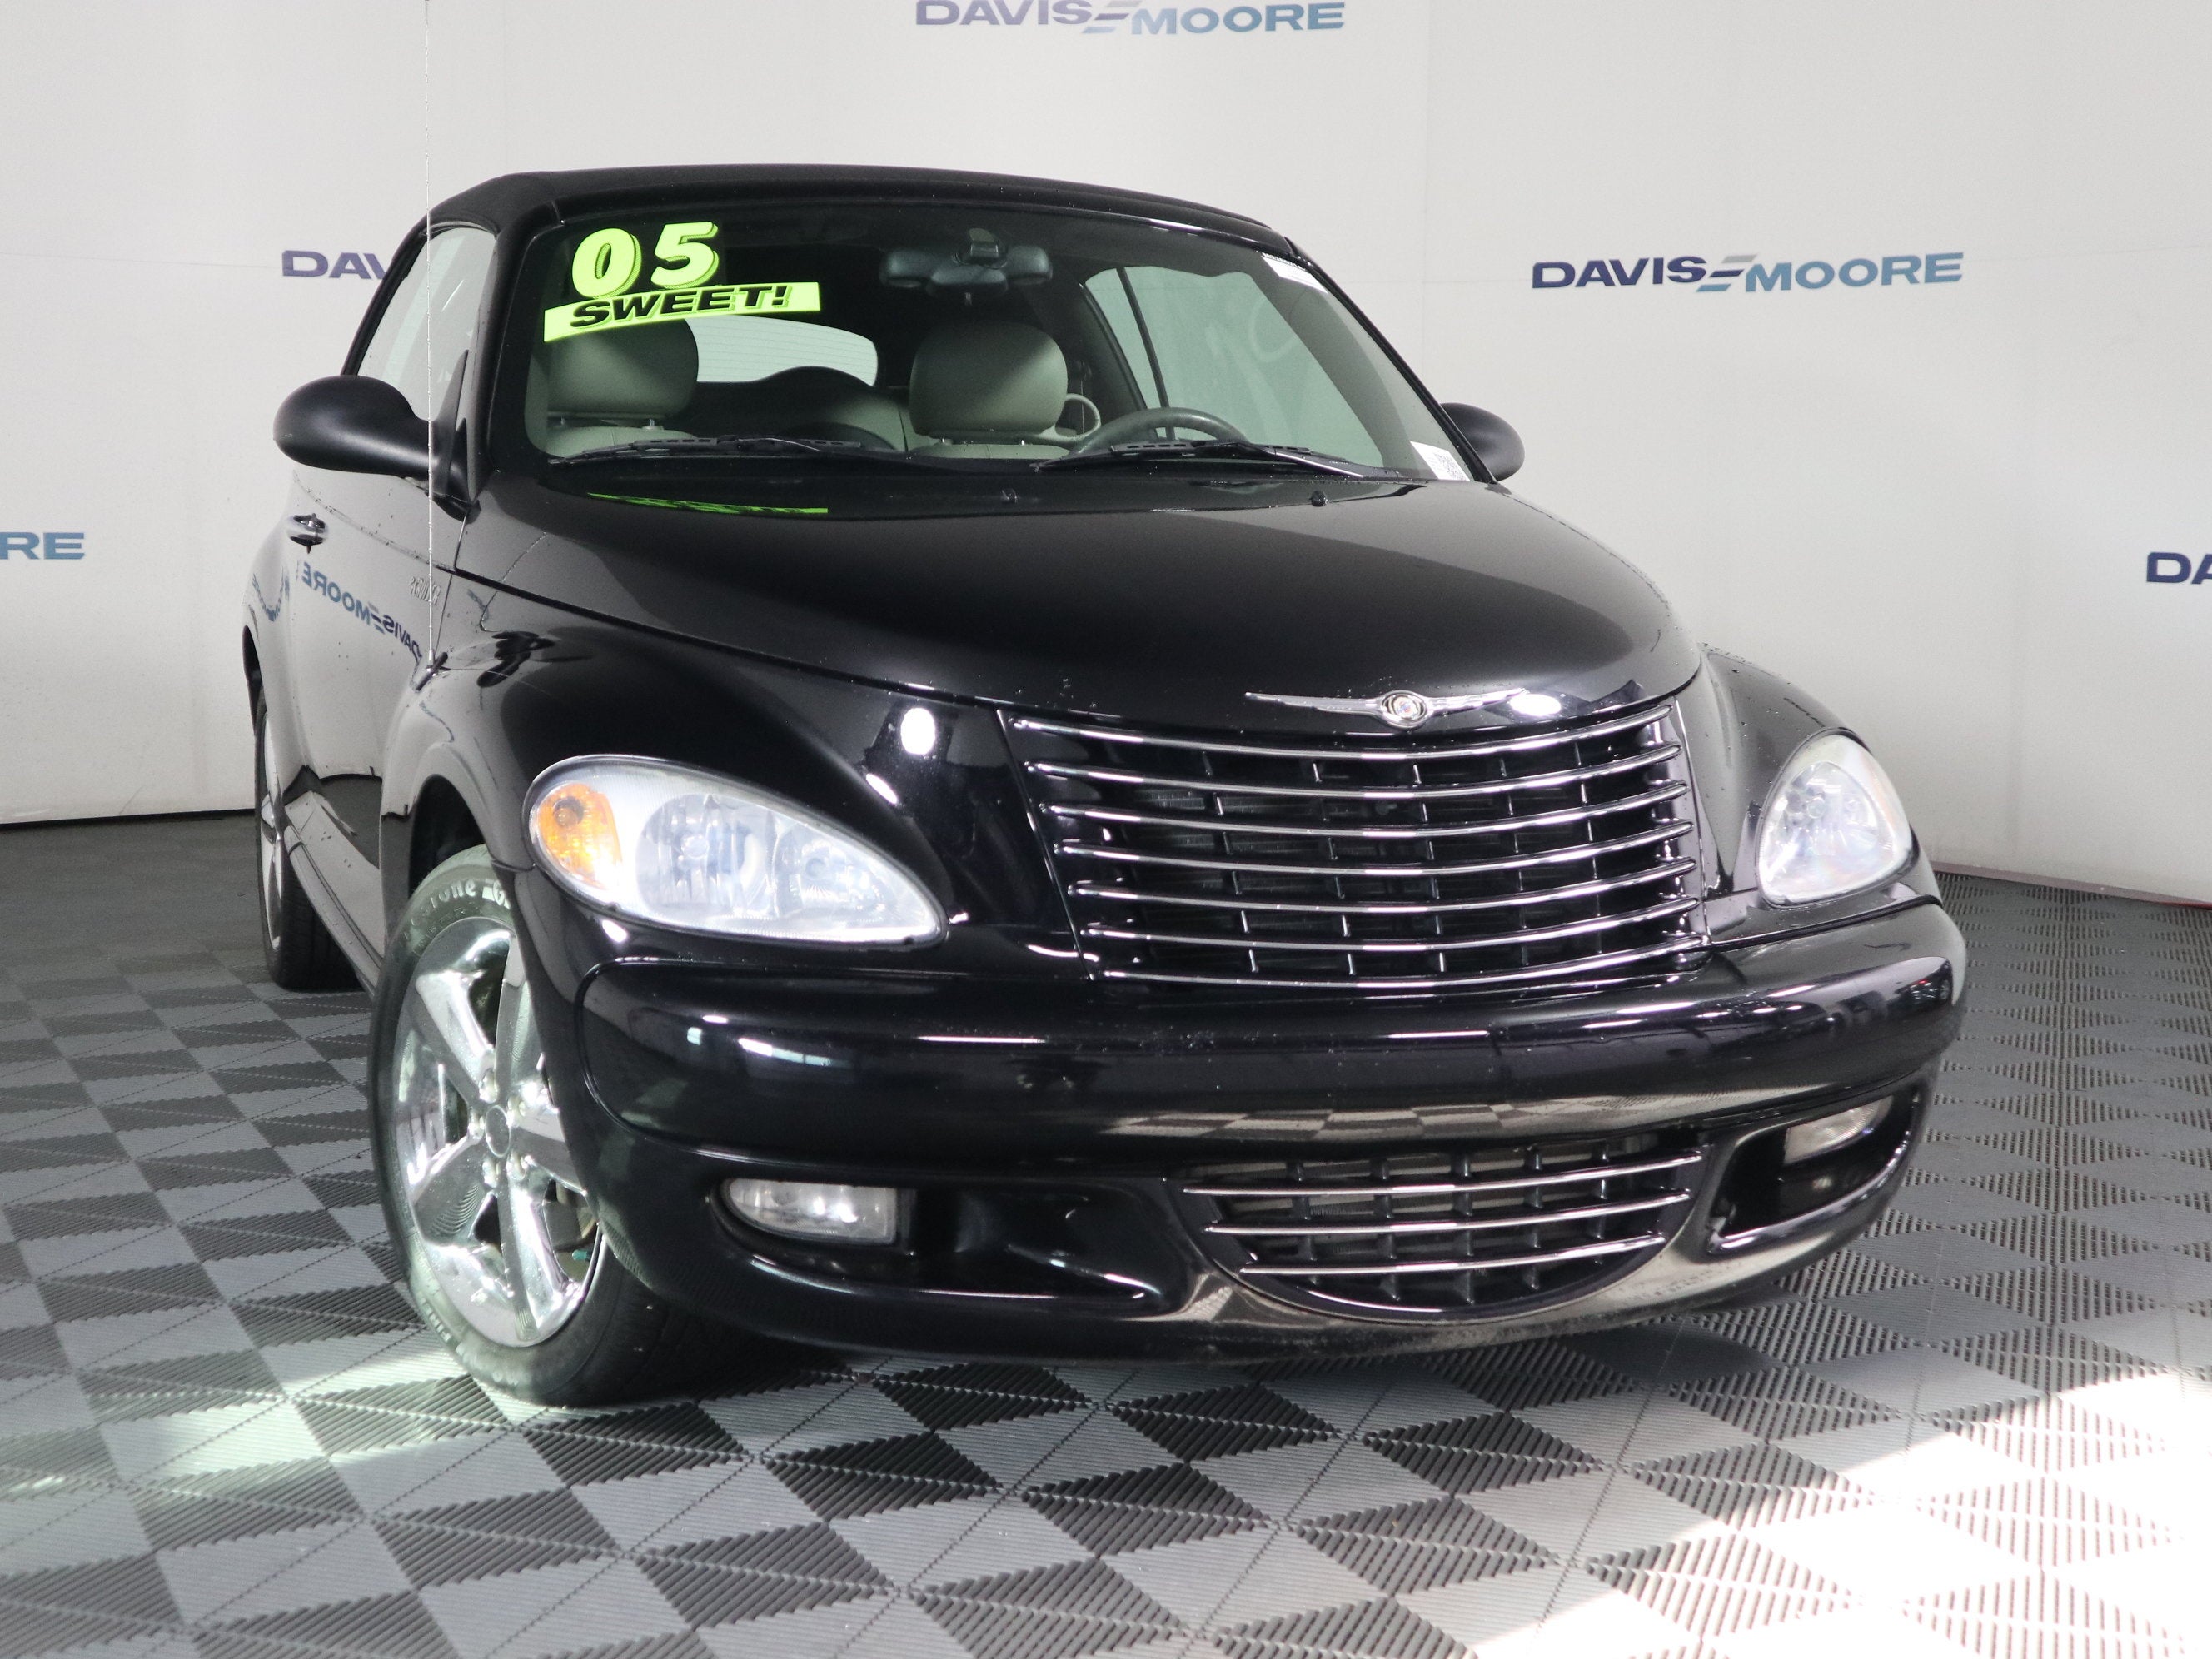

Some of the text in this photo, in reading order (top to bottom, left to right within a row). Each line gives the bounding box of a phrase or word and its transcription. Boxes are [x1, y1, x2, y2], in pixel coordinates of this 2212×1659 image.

[916, 0, 1344, 34] DAVIS MOORE
[571, 221, 720, 298] 05
[1532, 252, 1963, 292] DAVIS MOORE
[570, 286, 792, 329] SWEET!
